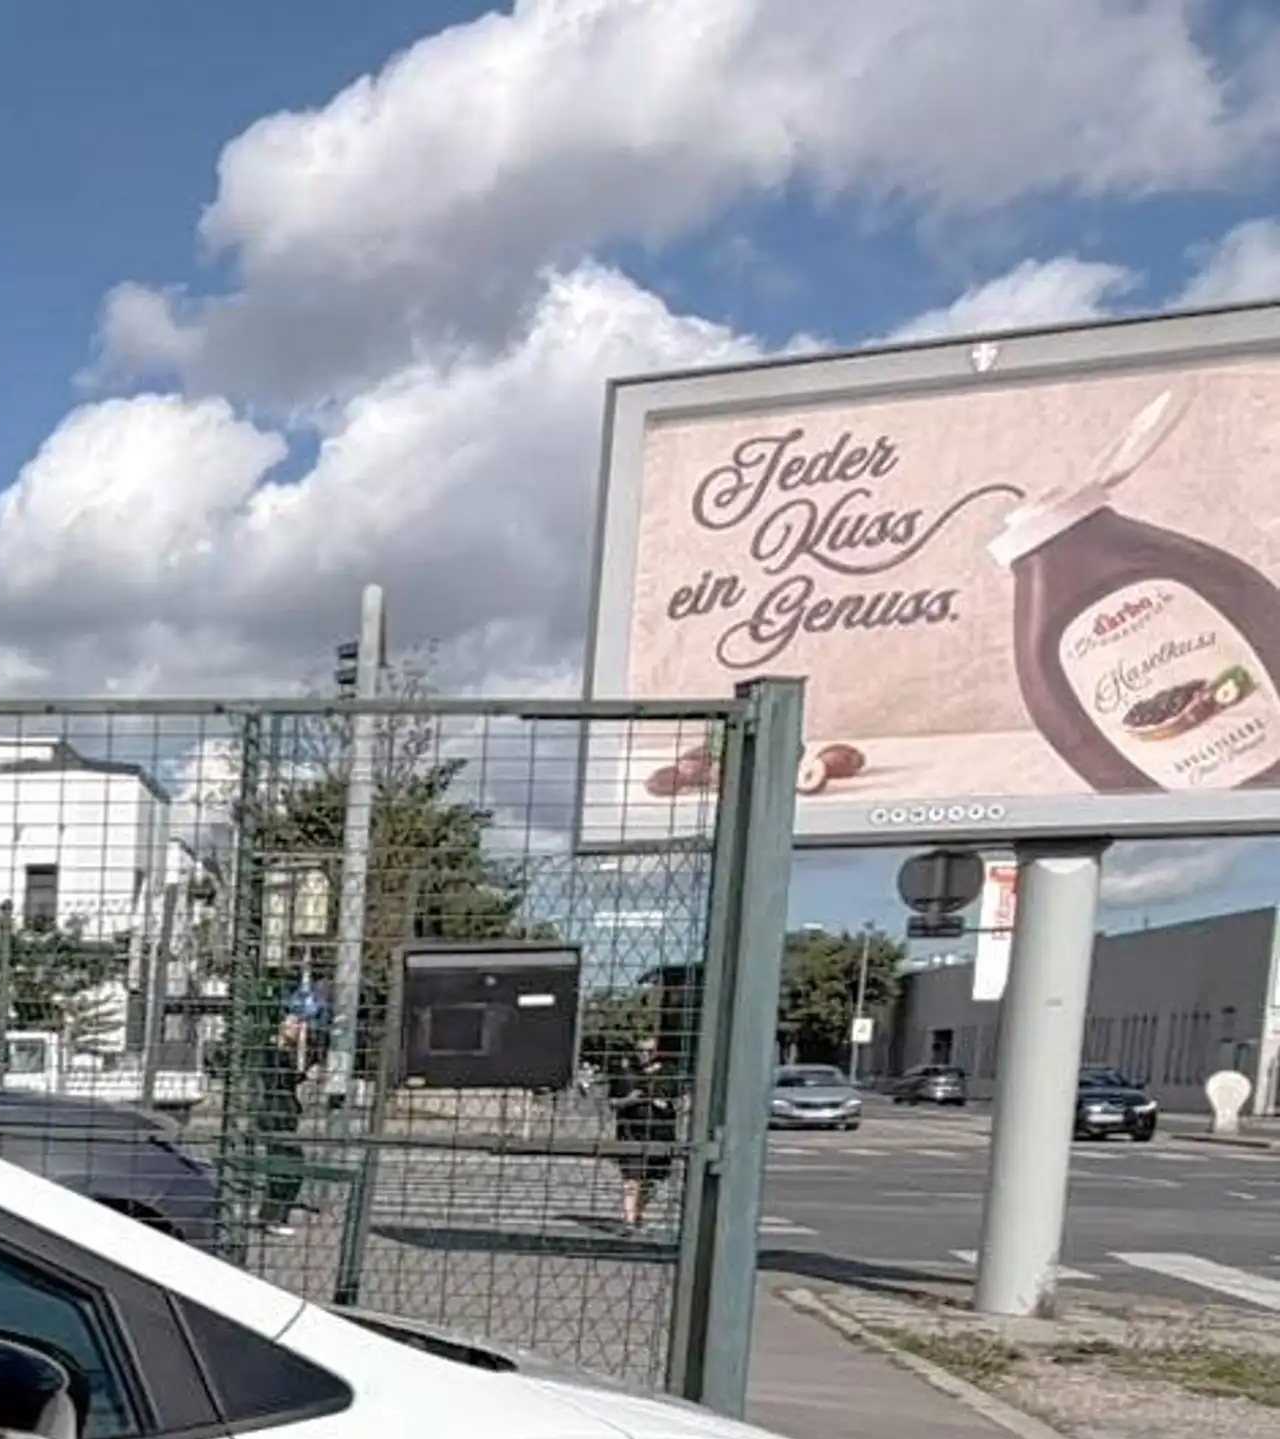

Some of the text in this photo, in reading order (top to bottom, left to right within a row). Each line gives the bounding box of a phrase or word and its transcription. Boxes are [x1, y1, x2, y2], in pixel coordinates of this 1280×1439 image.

[692, 428, 900, 530] Jeder
[750, 488, 1026, 575] Kuss
[667, 570, 961, 670] ein Genuss.
